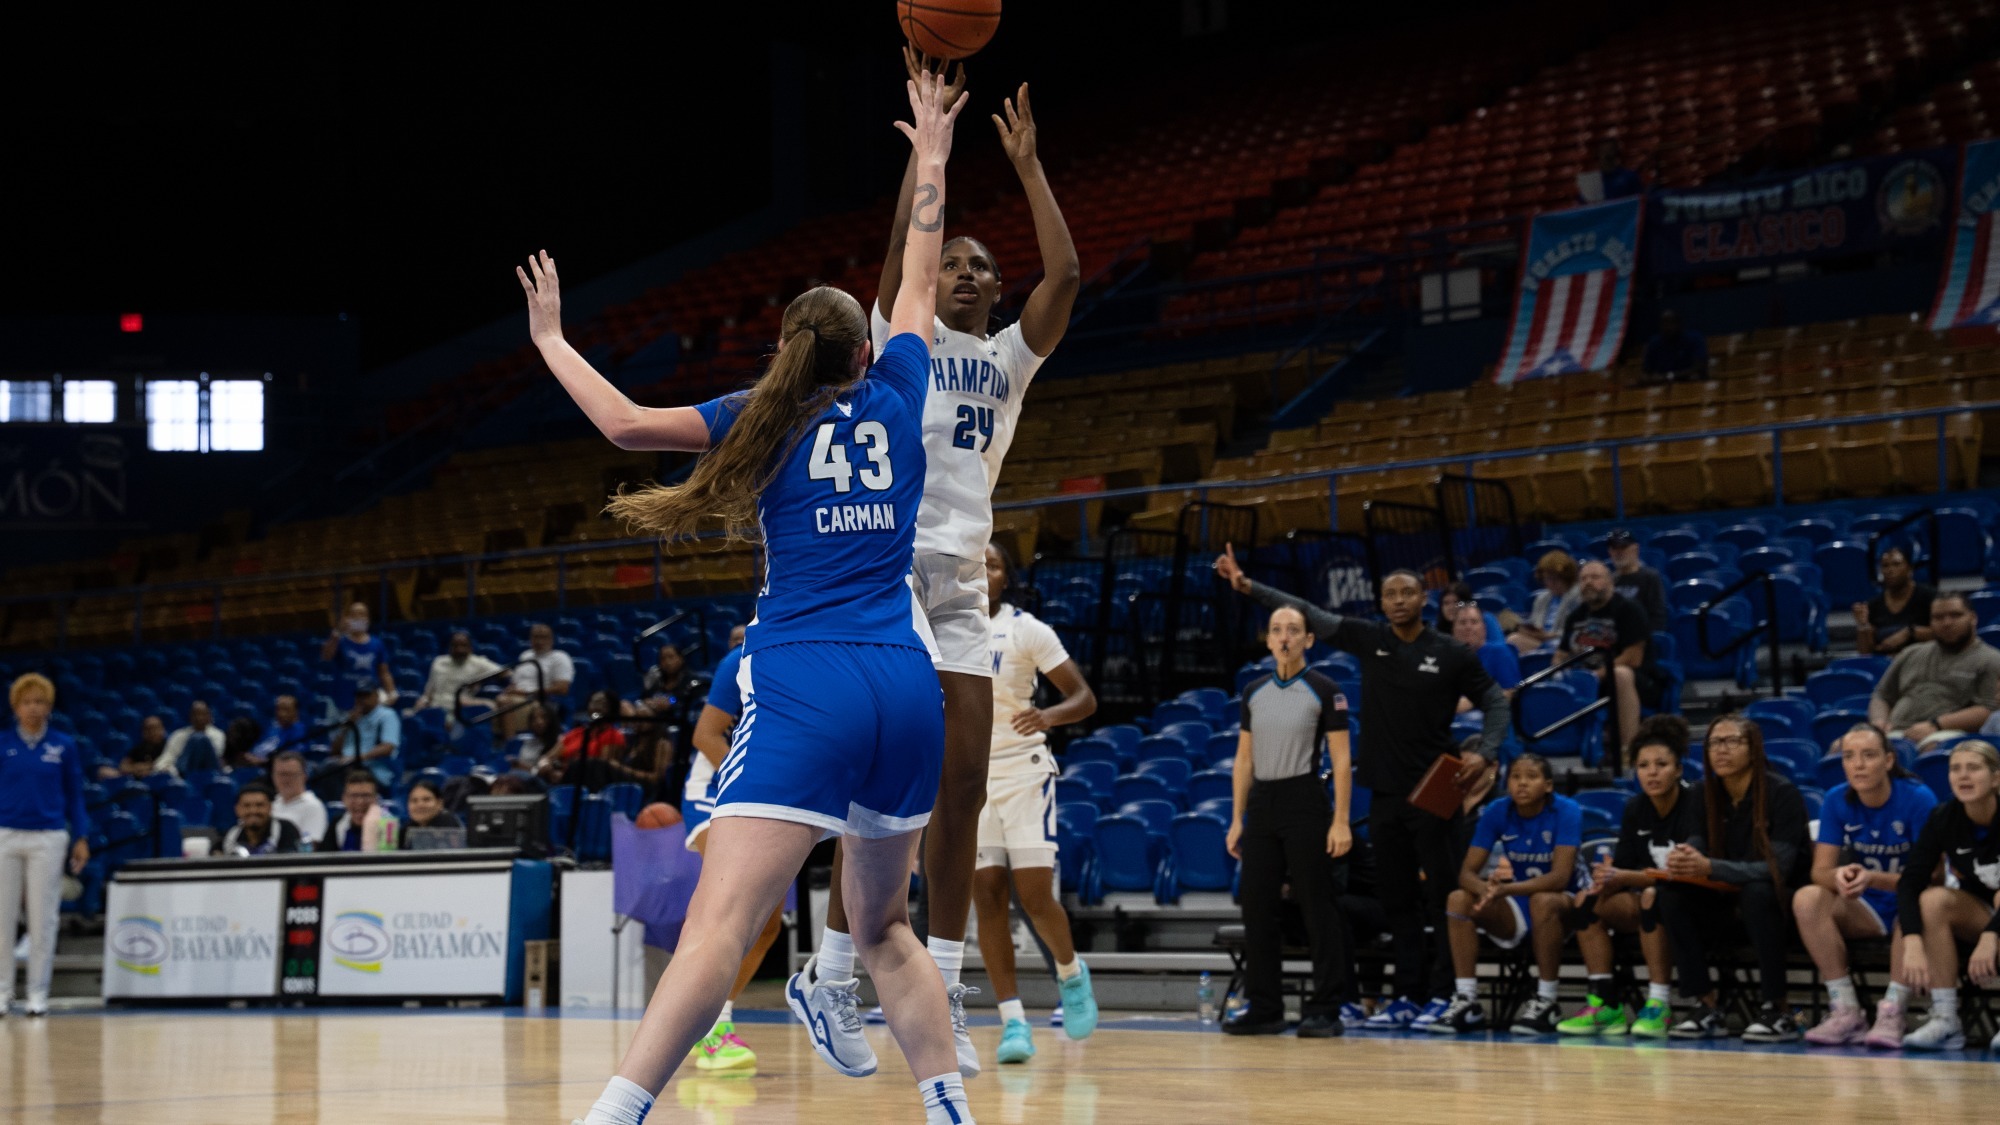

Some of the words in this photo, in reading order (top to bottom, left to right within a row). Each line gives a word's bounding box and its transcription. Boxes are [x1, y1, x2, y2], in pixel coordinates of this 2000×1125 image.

[931, 357, 1009, 404] HAMPTON
[952, 404, 994, 453] 24
[807, 420, 894, 493] 43
[815, 503, 895, 534] CARMAN
[393, 923, 503, 959] BAYAMÓN
